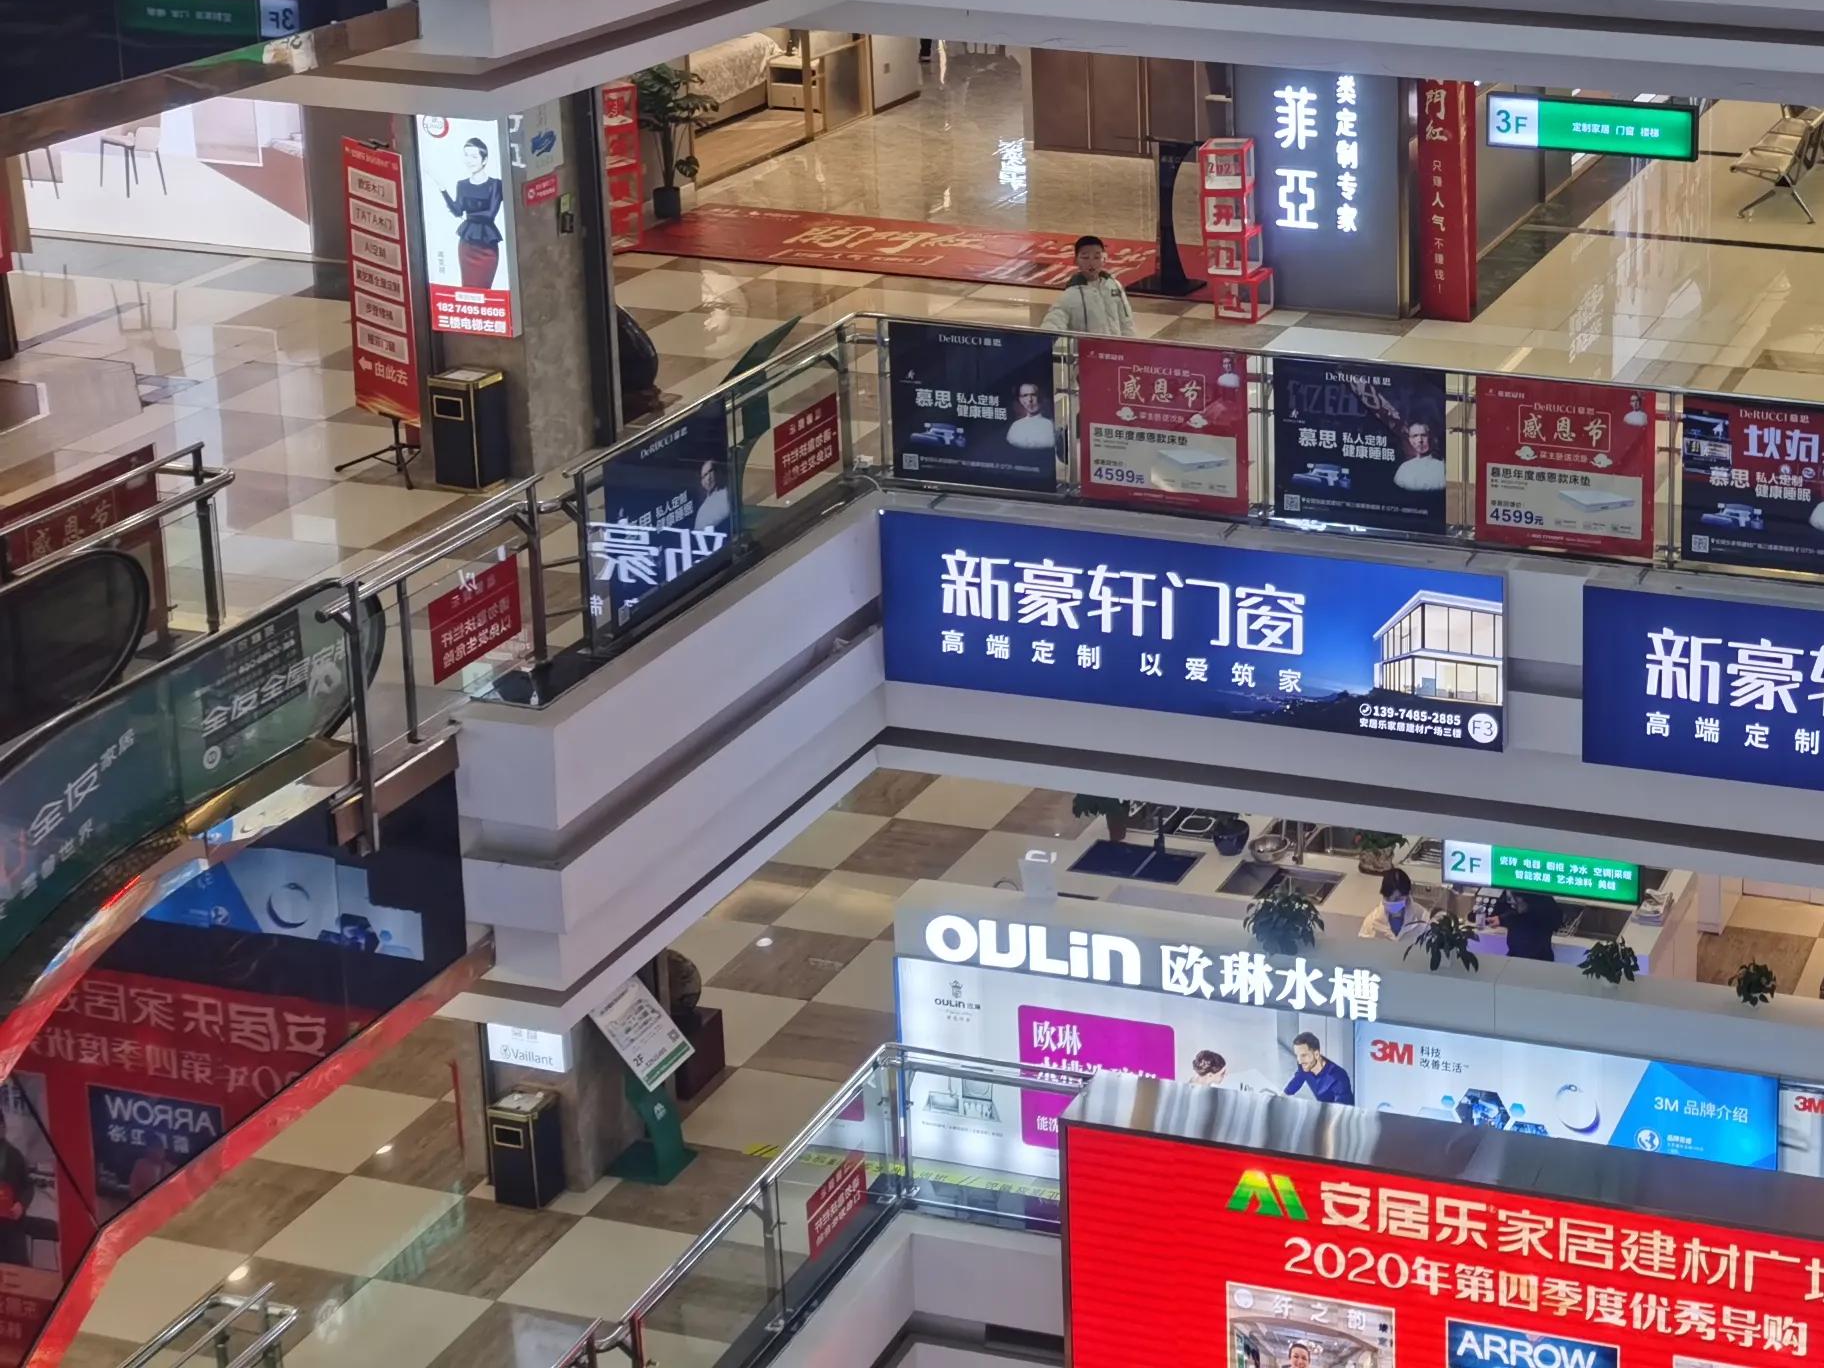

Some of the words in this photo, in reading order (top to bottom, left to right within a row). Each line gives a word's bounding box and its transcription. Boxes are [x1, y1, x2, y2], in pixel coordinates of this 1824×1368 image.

[1496, 109, 1527, 134] 3F
[1274, 86, 1319, 229] 菲亞
[436, 301, 454, 313] 182
[455, 304, 480, 316] 7495
[375, 362, 409, 386] 由此去
[915, 388, 952, 409] 慕思
[1299, 427, 1337, 448] 慕思
[1094, 467, 1144, 485] 4599元
[1710, 466, 1750, 488] 慕思
[1490, 508, 1544, 526] 4599元
[941, 549, 1304, 655] 新豪轩门窗
[941, 629, 1102, 670] 高端定制
[1140, 652, 1303, 692] 以爱筑家
[1373, 704, 1461, 725] 139-7485-2885
[1472, 719, 1494, 737] F3
[1646, 712, 1820, 754] 高端定制
[1451, 850, 1482, 874] 2F
[1161, 944, 1382, 1023] 欧琳水槽
[1032, 1020, 1082, 1054] 欧琳
[511, 1047, 554, 1067] Vaillant
[1370, 1039, 1414, 1066] 3M
[1420, 1046, 1441, 1058] 科技
[1420, 1058, 1463, 1074] 改善生活
[1653, 1096, 1679, 1113] 3M
[1684, 1100, 1748, 1124] 品牌介绍
[1283, 1237, 1808, 1357] 2020年第四季度优秀导购
[1456, 1332, 1599, 1368] ARROW
